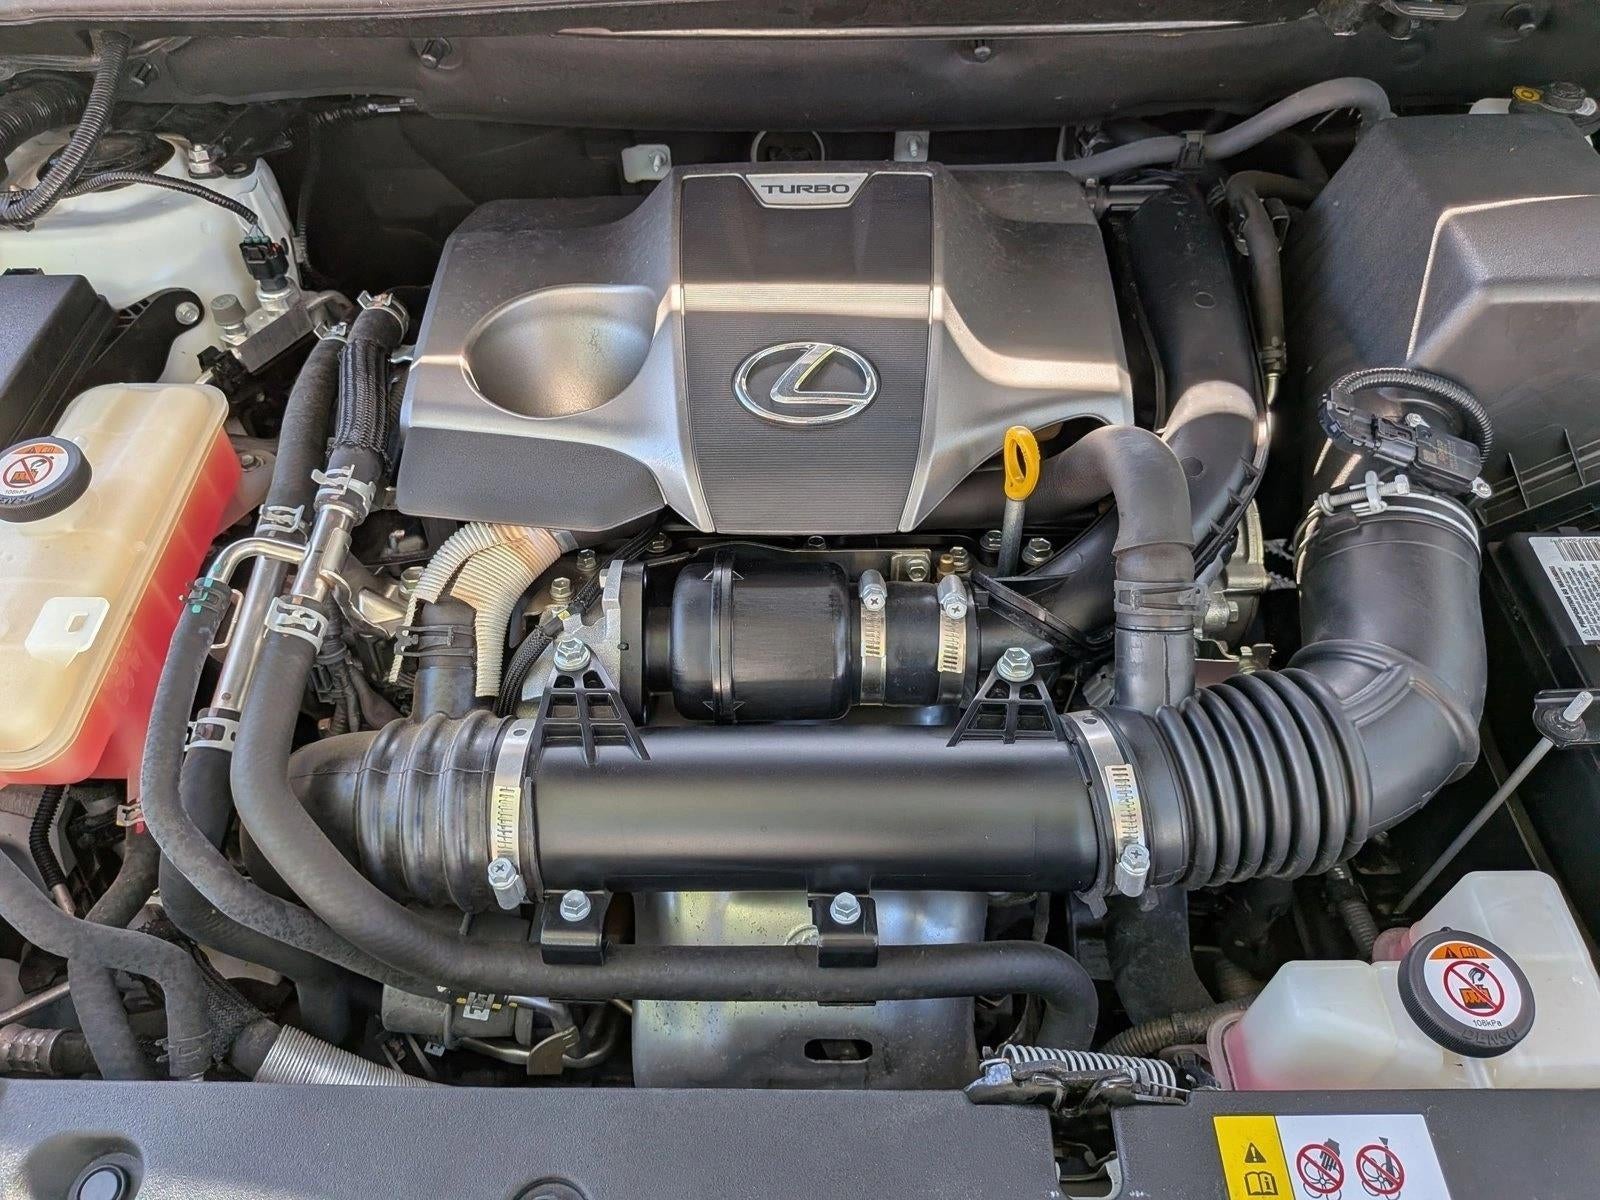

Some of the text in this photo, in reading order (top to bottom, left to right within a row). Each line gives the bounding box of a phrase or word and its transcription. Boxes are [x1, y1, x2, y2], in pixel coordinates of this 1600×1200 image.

[760, 184, 850, 194] TURBO
[1472, 1019, 1503, 1028] 108kPa
[1461, 1028, 1518, 1047] DENSO
